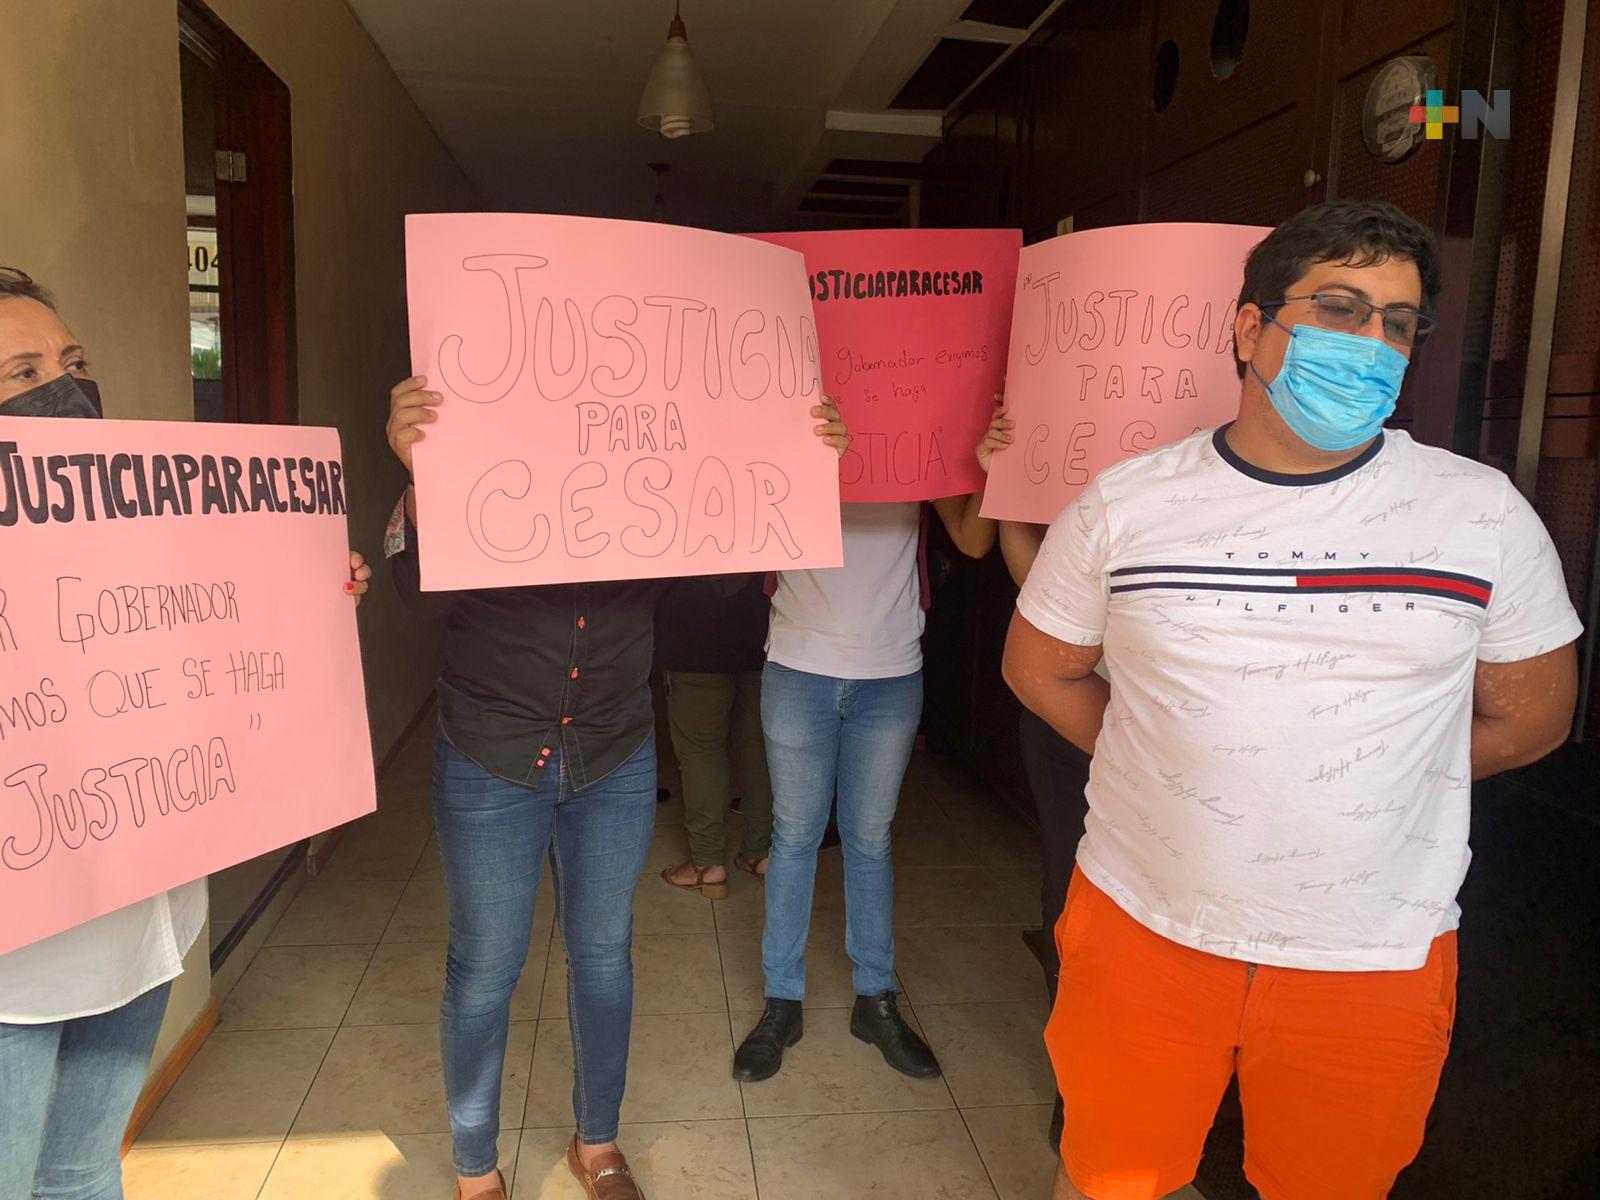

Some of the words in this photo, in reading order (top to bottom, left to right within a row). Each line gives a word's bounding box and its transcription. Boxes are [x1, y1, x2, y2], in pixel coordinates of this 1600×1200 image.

[1076, 365, 1198, 404] PARA
[575, 401, 687, 456] PARA
[466, 456, 803, 563] CESAR
[1225, 551, 1370, 561] TOMMY
[56, 576, 240, 653] GOBERNADOR
[87, 667, 167, 719] QUE
[182, 656, 215, 699] SE
[225, 650, 286, 696] HAGA
[1, 737, 236, 871] JUSTICIA
